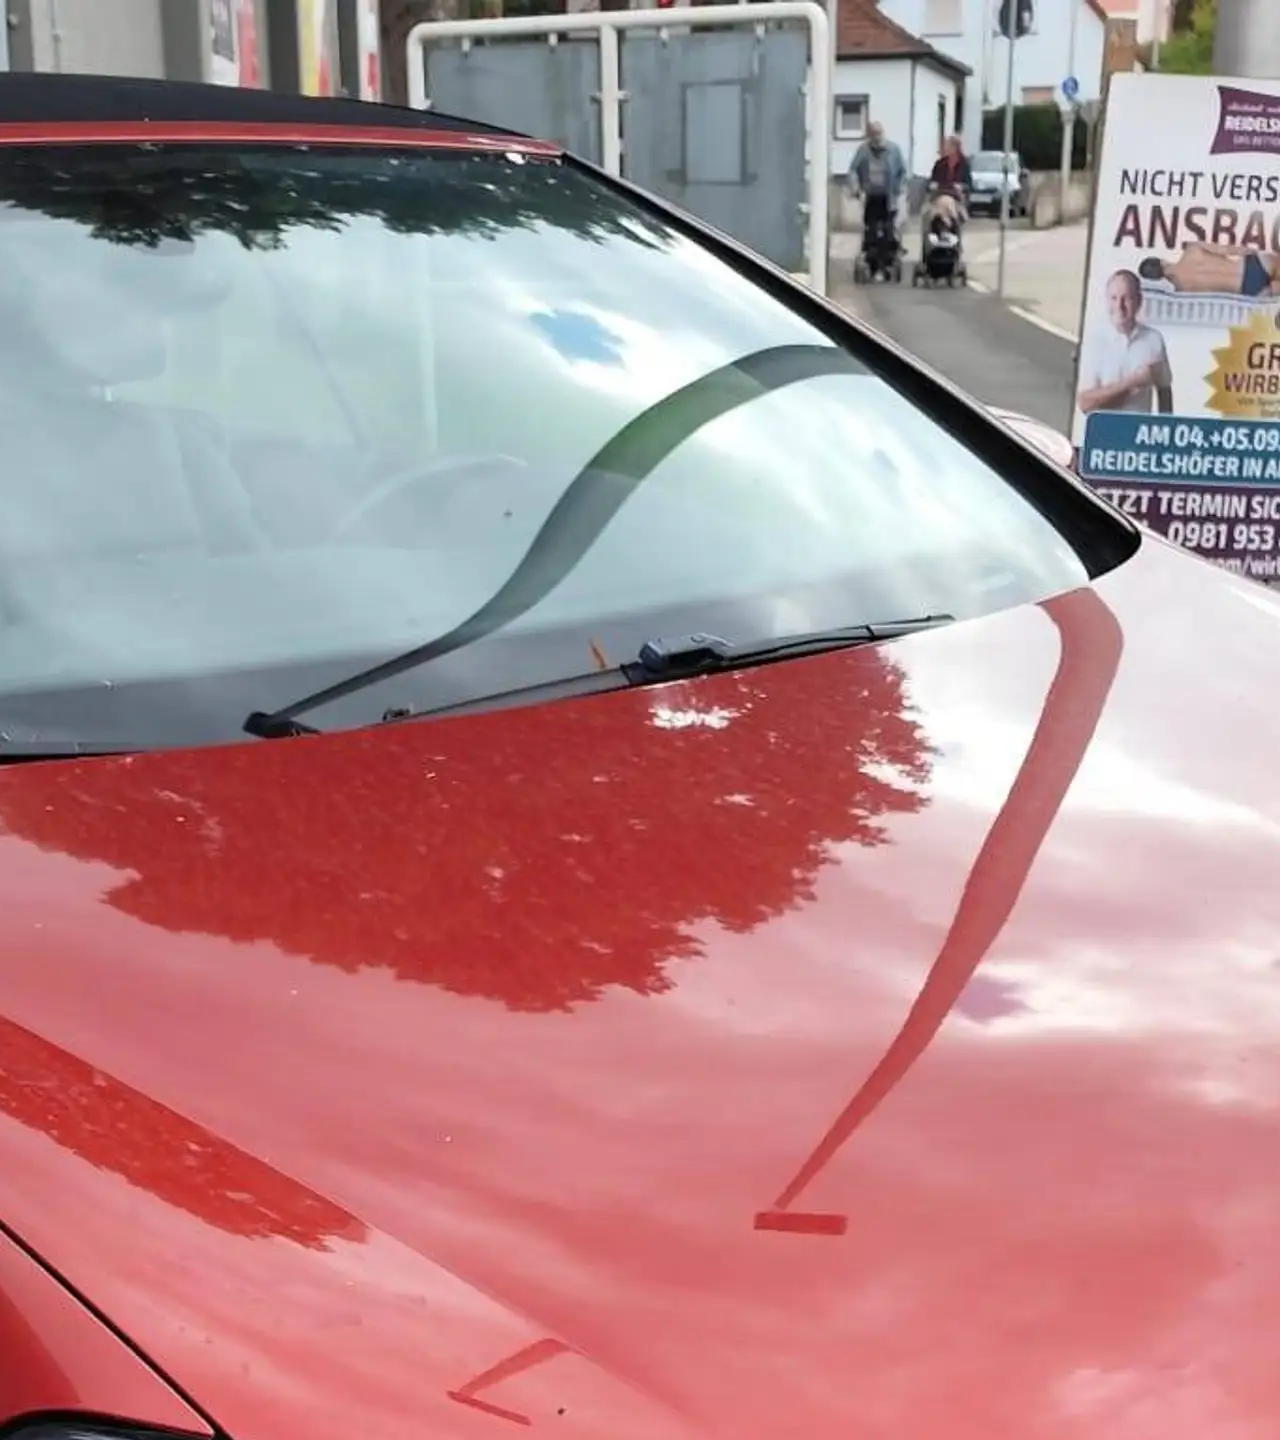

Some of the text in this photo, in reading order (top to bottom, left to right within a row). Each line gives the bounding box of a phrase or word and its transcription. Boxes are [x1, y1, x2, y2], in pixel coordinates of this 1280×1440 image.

[1119, 168, 1204, 198] NICHT
[1135, 424, 1170, 447] AM
[1089, 448, 1240, 478] REIDELSHÖFER
[1241, 458, 1264, 478] IN
[1156, 490, 1247, 518] TERMIN
[1167, 520, 1229, 549] 0981
[1232, 523, 1274, 551] 953
